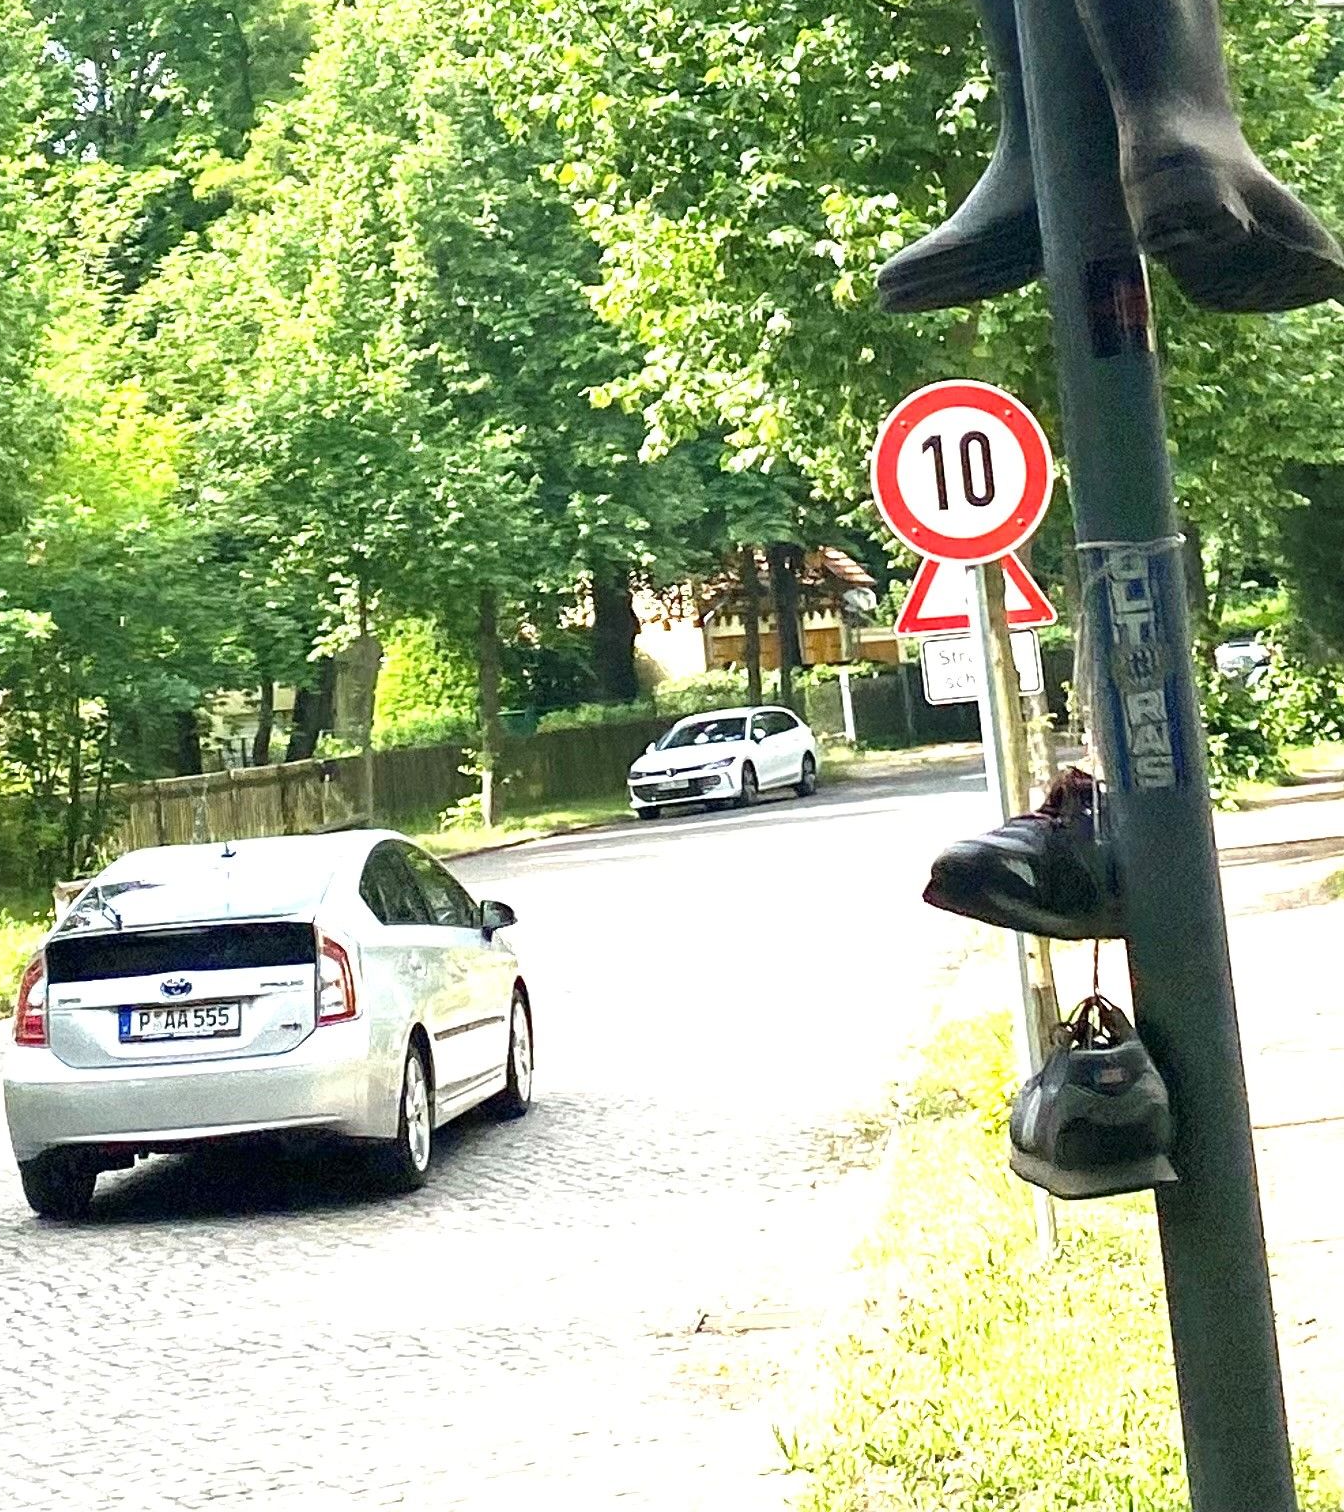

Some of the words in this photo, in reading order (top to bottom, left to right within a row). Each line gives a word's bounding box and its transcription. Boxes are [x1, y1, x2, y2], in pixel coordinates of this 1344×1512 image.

[921, 430, 997, 511] 10
[139, 1012, 151, 1031] P
[164, 1009, 188, 1029] AA
[193, 1006, 230, 1028] 555
